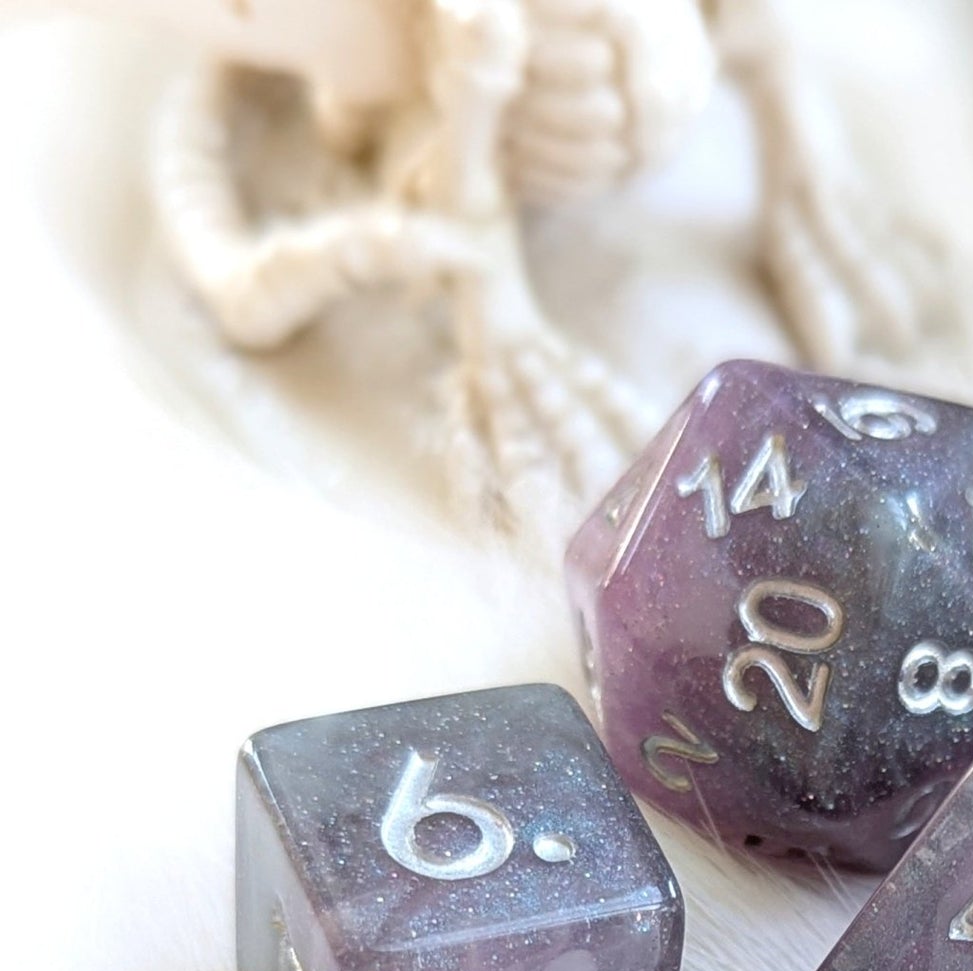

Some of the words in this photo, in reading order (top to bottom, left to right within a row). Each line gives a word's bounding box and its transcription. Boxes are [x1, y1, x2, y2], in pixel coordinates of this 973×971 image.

[677, 434, 807, 539] 14
[723, 578, 846, 733] 20
[640, 708, 719, 794] 2
